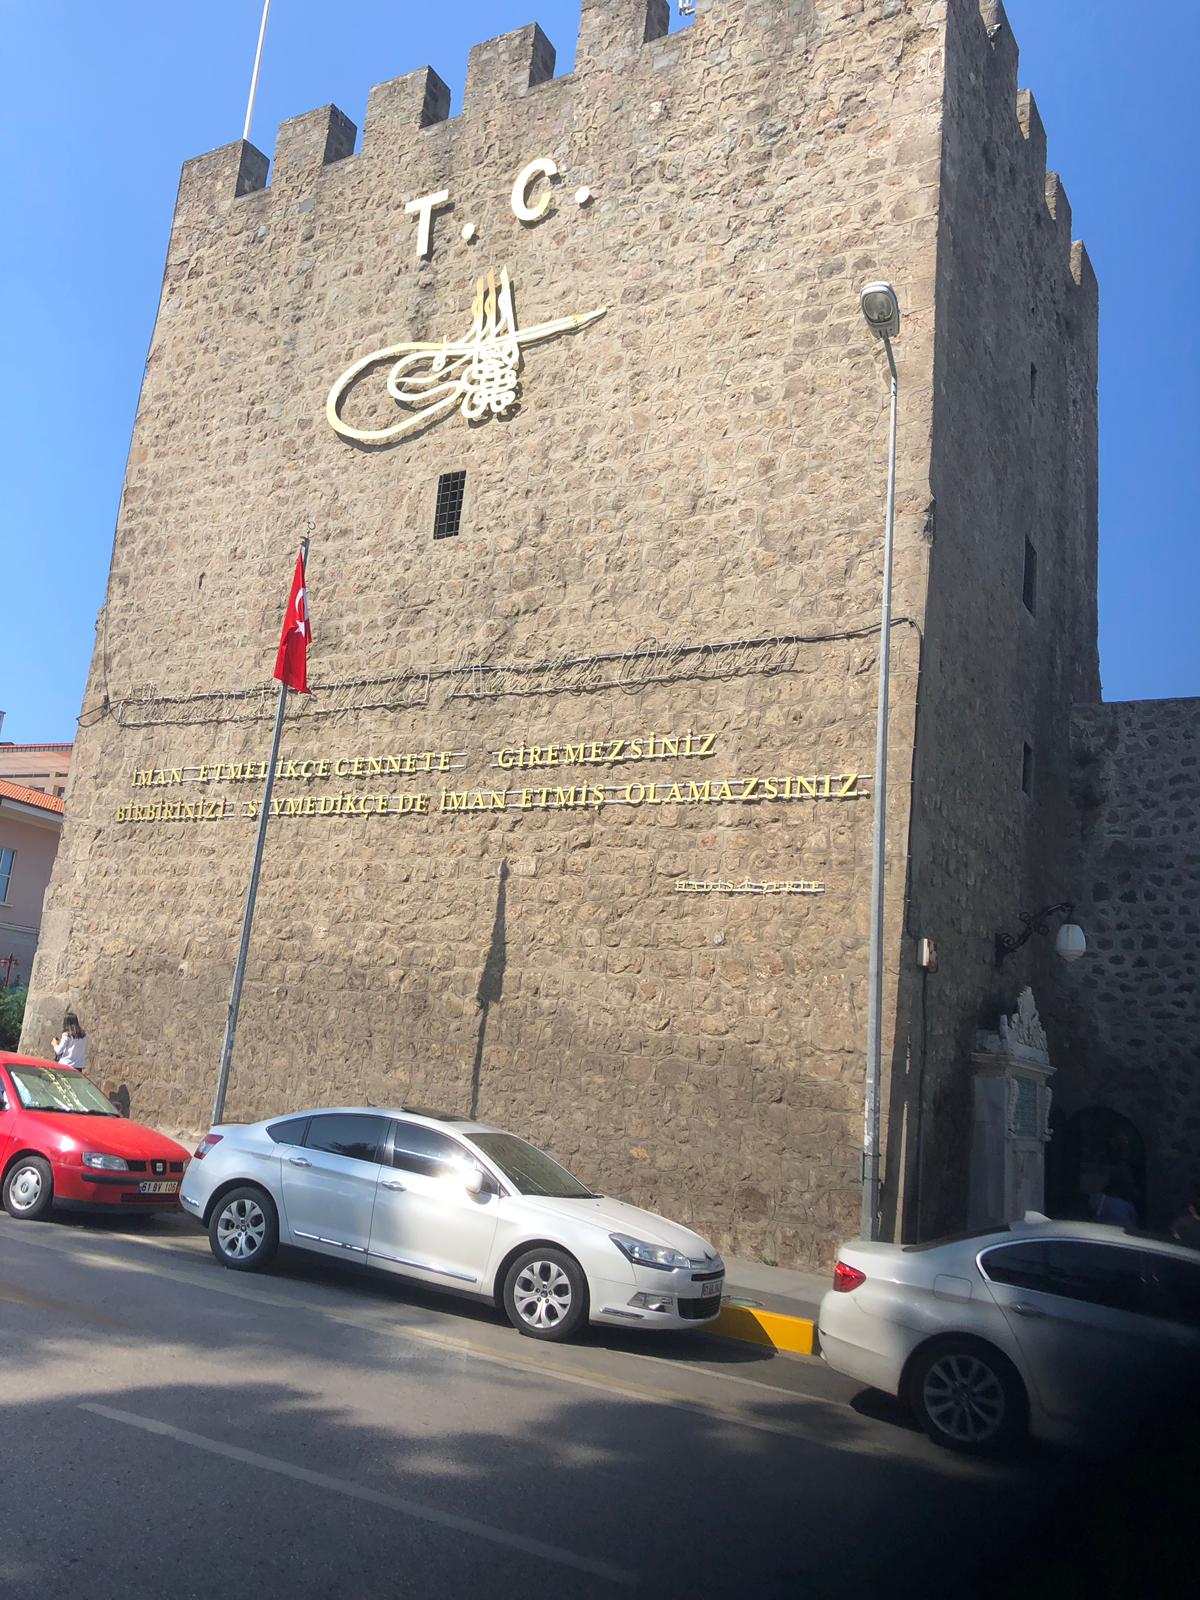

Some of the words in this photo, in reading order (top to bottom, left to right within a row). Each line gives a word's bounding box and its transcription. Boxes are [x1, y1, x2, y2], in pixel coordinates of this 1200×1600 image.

[335, 752, 452, 777] CENNETE
[498, 729, 717, 768] GİREMEZSİNİZ
[116, 796, 226, 822] BİRBİRİNİZİ
[248, 791, 388, 820] SVMEDİKÇE
[399, 793, 428, 812] DE
[440, 787, 507, 811] İMAN
[521, 780, 605, 811] ETMİŞ
[626, 773, 858, 804] OLAMAZSINIZ
